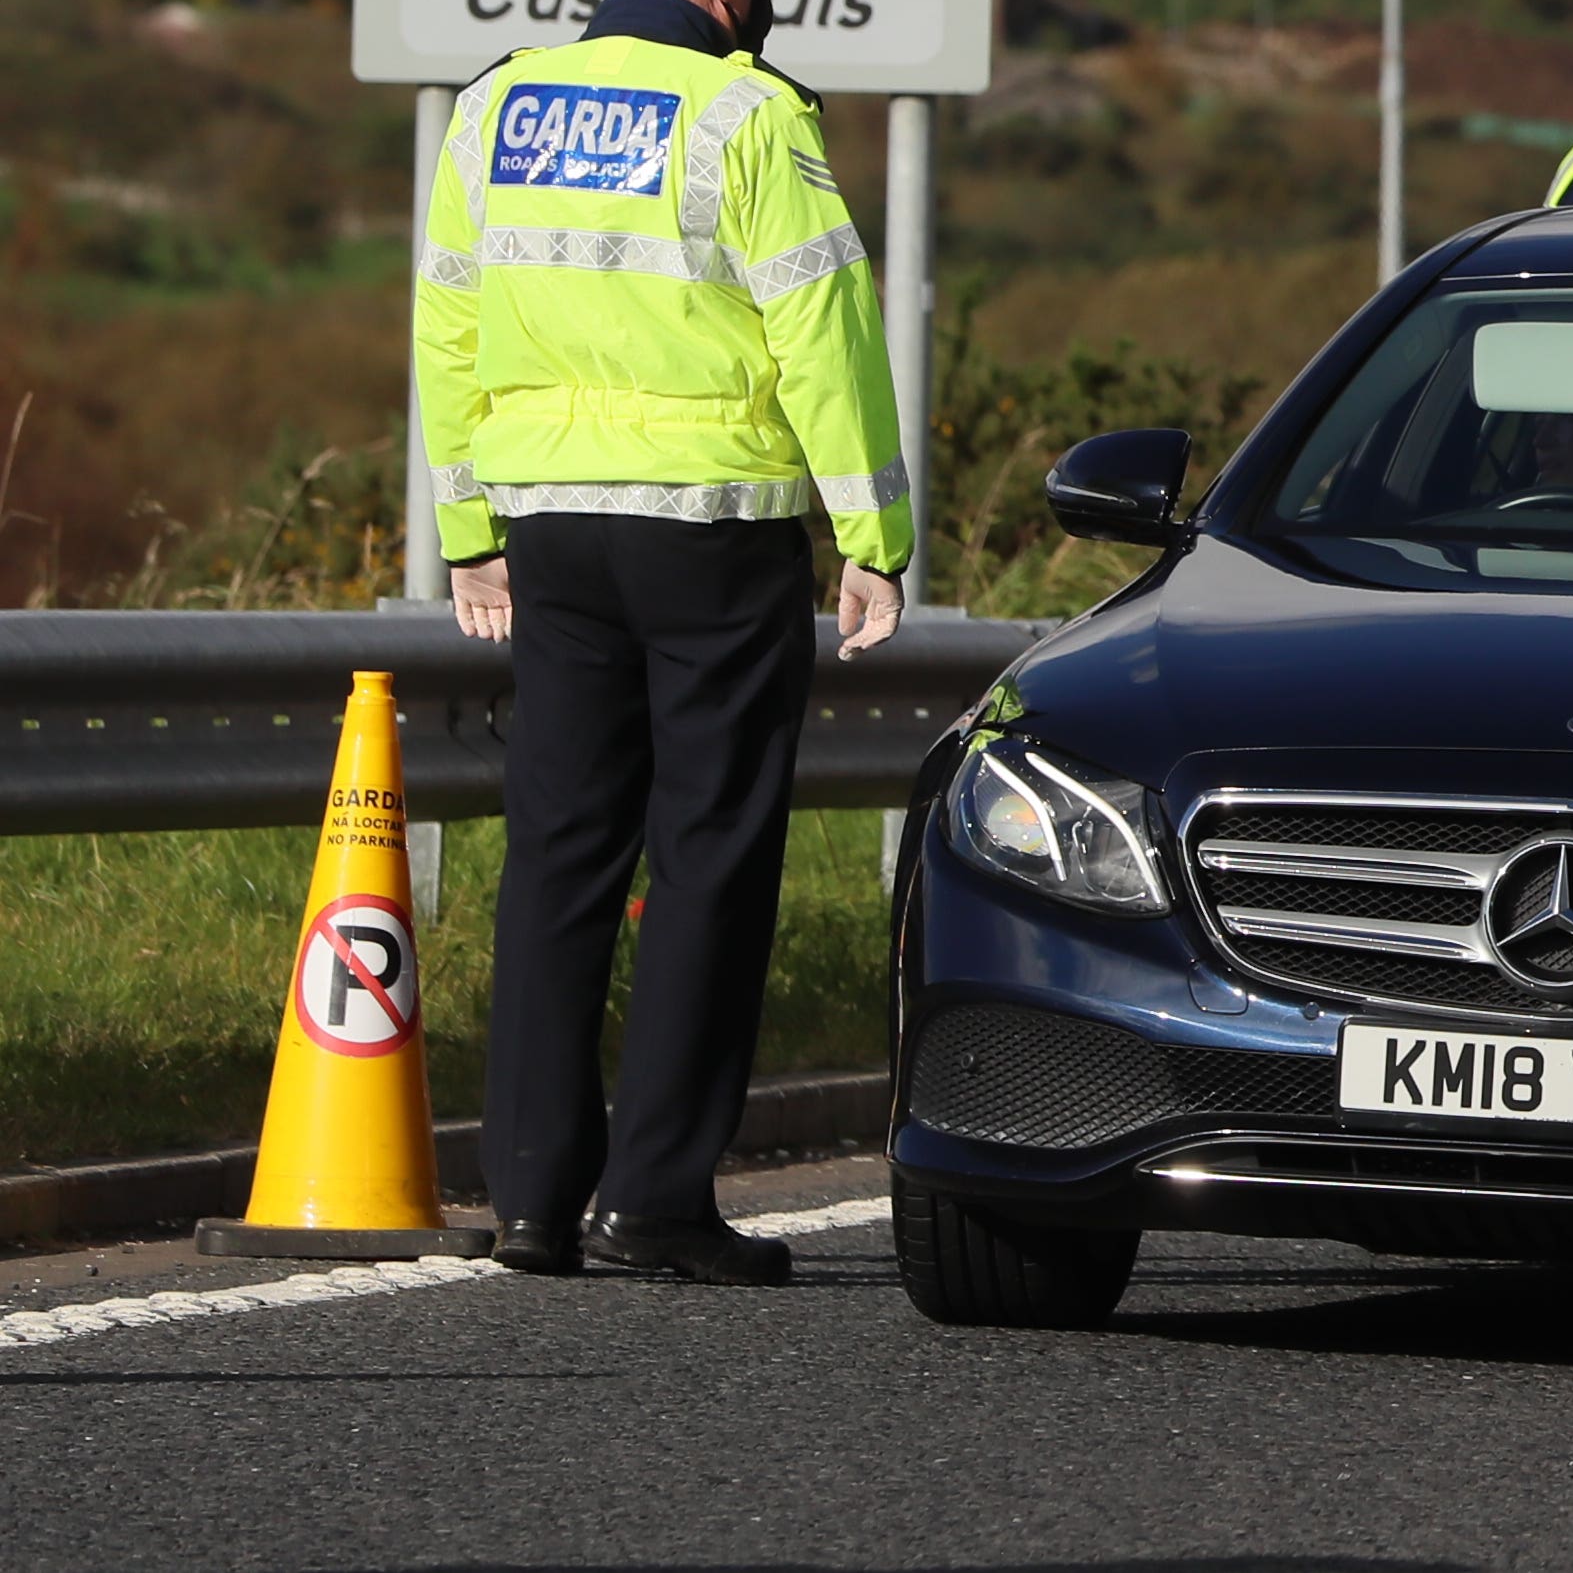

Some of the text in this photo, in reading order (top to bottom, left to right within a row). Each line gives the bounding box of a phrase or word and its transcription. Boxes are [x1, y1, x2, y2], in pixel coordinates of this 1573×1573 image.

[503, 95, 658, 158] GARDA
[332, 811, 348, 827] NÁ
[327, 834, 344, 845] NO
[1382, 1038, 1544, 1112] KM18
